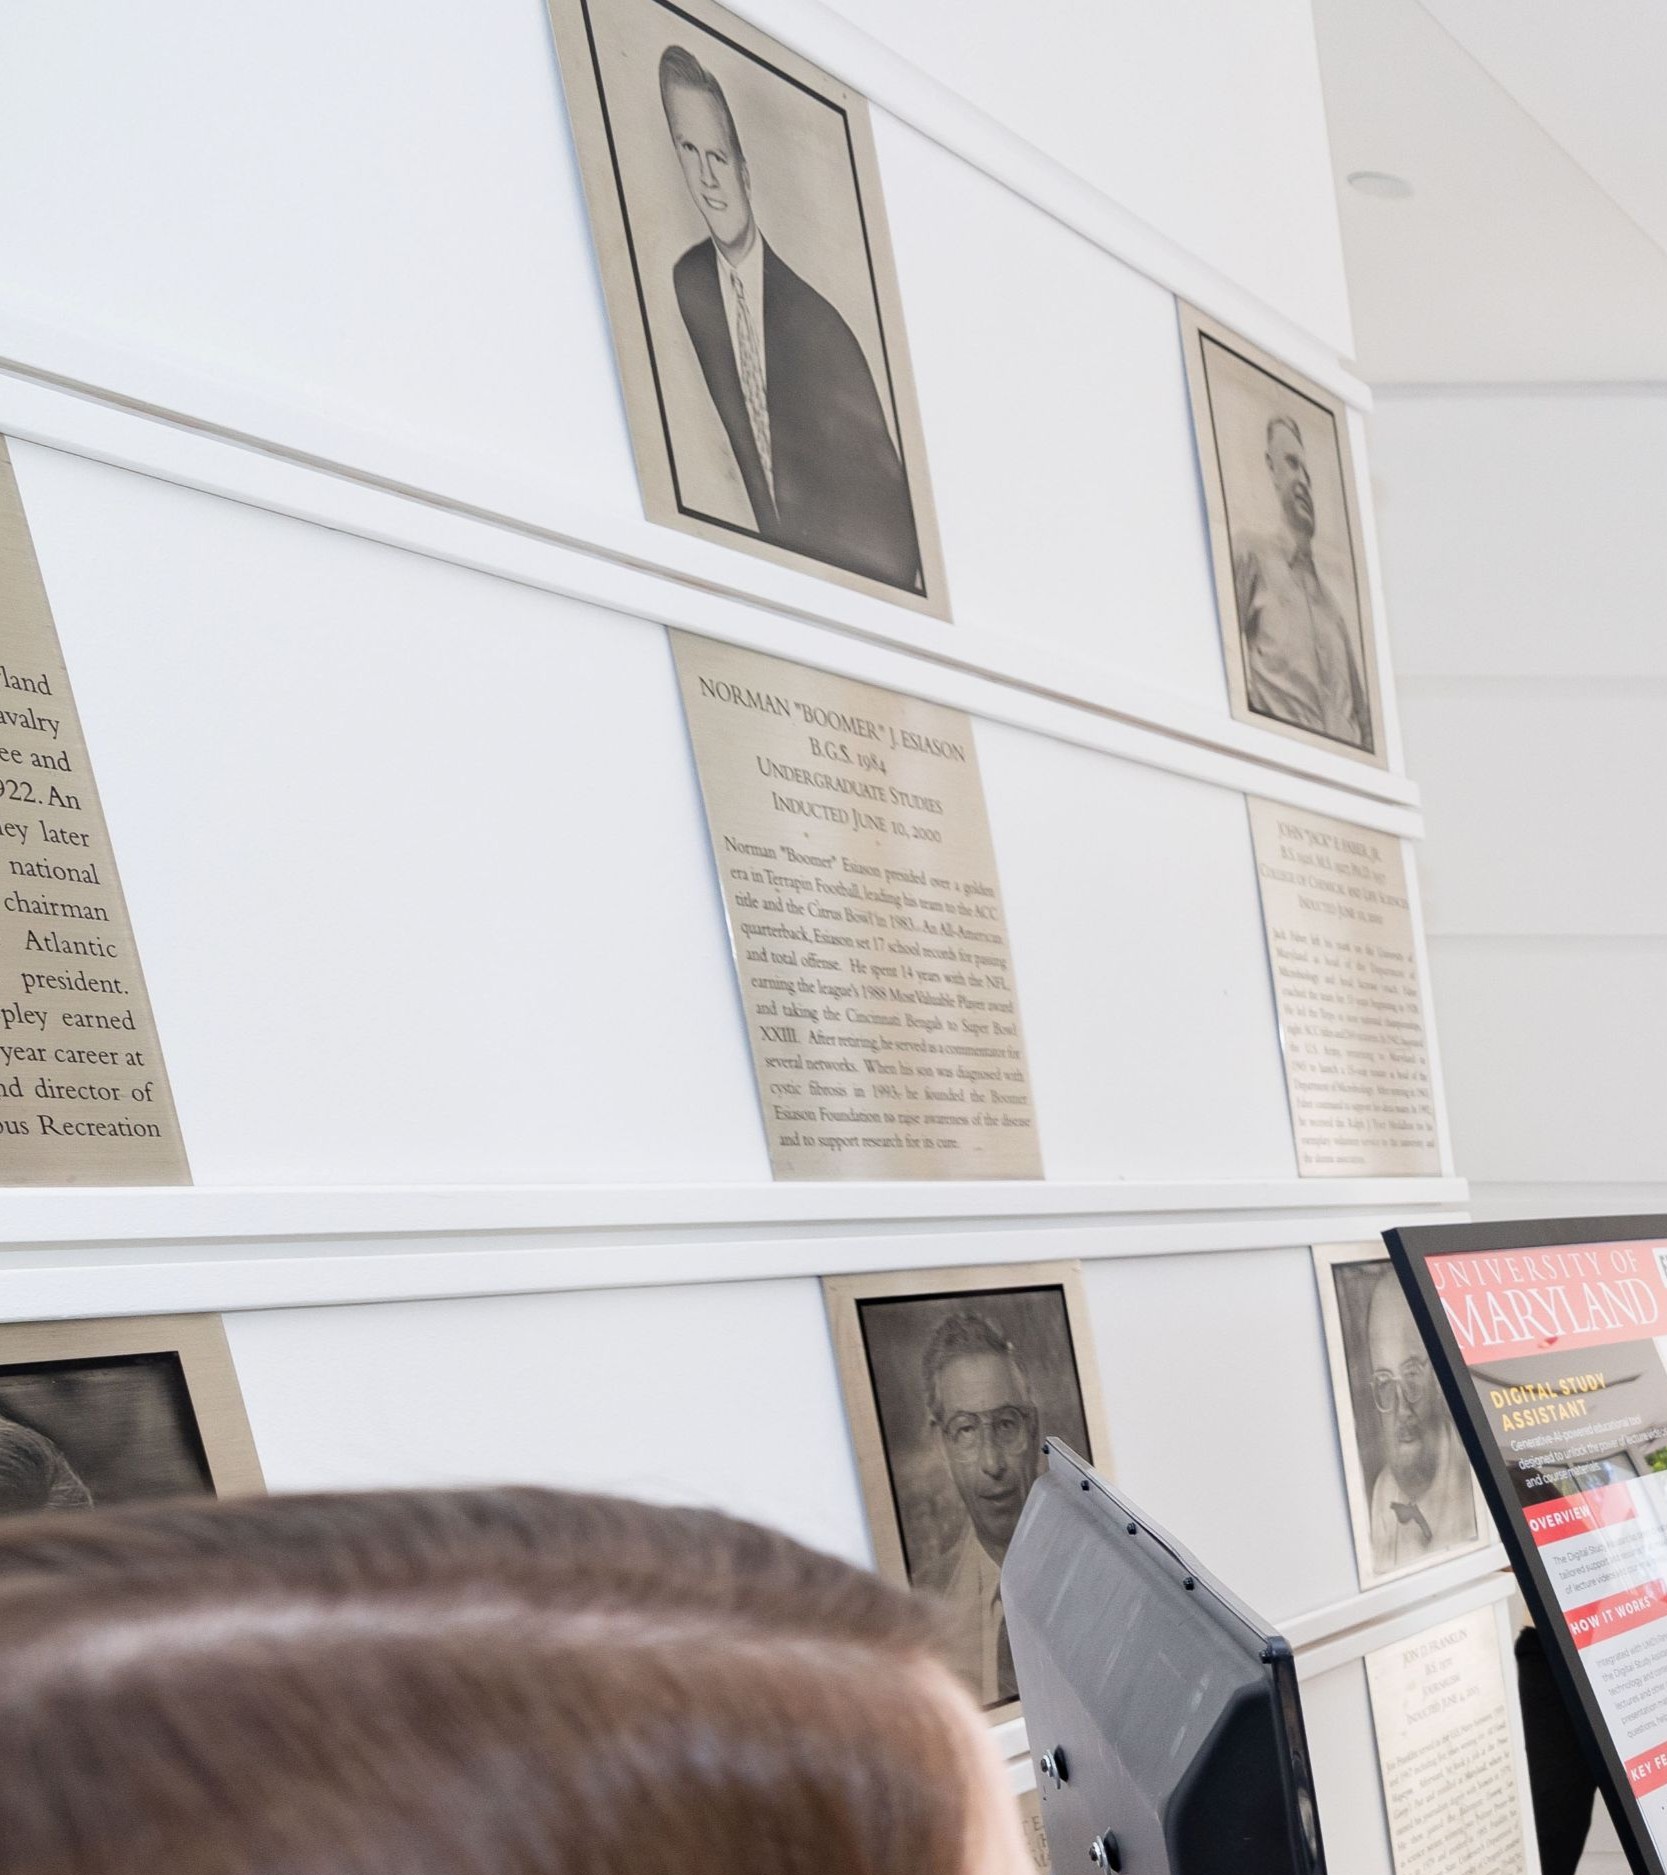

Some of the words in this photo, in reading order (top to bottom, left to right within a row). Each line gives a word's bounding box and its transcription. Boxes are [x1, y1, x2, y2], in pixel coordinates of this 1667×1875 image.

[0, 666, 52, 696] land
[697, 676, 791, 718] NORMAN
[900, 729, 966, 763] ESIASON
[31, 751, 72, 772] and
[808, 736, 853, 765] B.G.S.
[48, 786, 81, 810] An
[755, 756, 887, 803] UNDERGRADUATE
[888, 786, 943, 815] STUDIES
[771, 791, 849, 825] INDUCTED
[851, 808, 888, 837] JUNE
[0, 821, 28, 845] ey
[39, 820, 89, 847] later
[723, 836, 776, 859] Norman
[9, 859, 100, 885] national
[4, 891, 109, 922] chairman
[25, 929, 118, 958] Atlantic
[21, 970, 129, 995] president.
[62, 1010, 136, 1030] earned
[1, 1046, 47, 1066] year
[54, 1048, 119, 1065] career
[126, 1050, 144, 1066] at
[35, 1078, 120, 1101] director
[132, 1082, 153, 1102] of
[37, 1115, 161, 1137] Recreation
[1433, 1251, 1602, 1290] UNIVERSITY
[1610, 1249, 1638, 1274] OF
[1440, 1278, 1659, 1350] MARYLAND
[1490, 1382, 1558, 1409] DIGITAL
[1559, 1373, 1607, 1396] STUDY
[1502, 1400, 1588, 1432] ASSISTANT
[1519, 1453, 1555, 1470] designed
[1556, 1452, 1564, 1461] to
[1526, 1475, 1543, 1488] and
[1543, 1469, 1568, 1484] course
[1529, 1504, 1592, 1532] OVERVIEW
[1570, 1616, 1600, 1635] HOW
[1602, 1610, 1615, 1624] IT
[1615, 1597, 1651, 1618] WORKS
[1631, 1760, 1652, 1782] KEY
